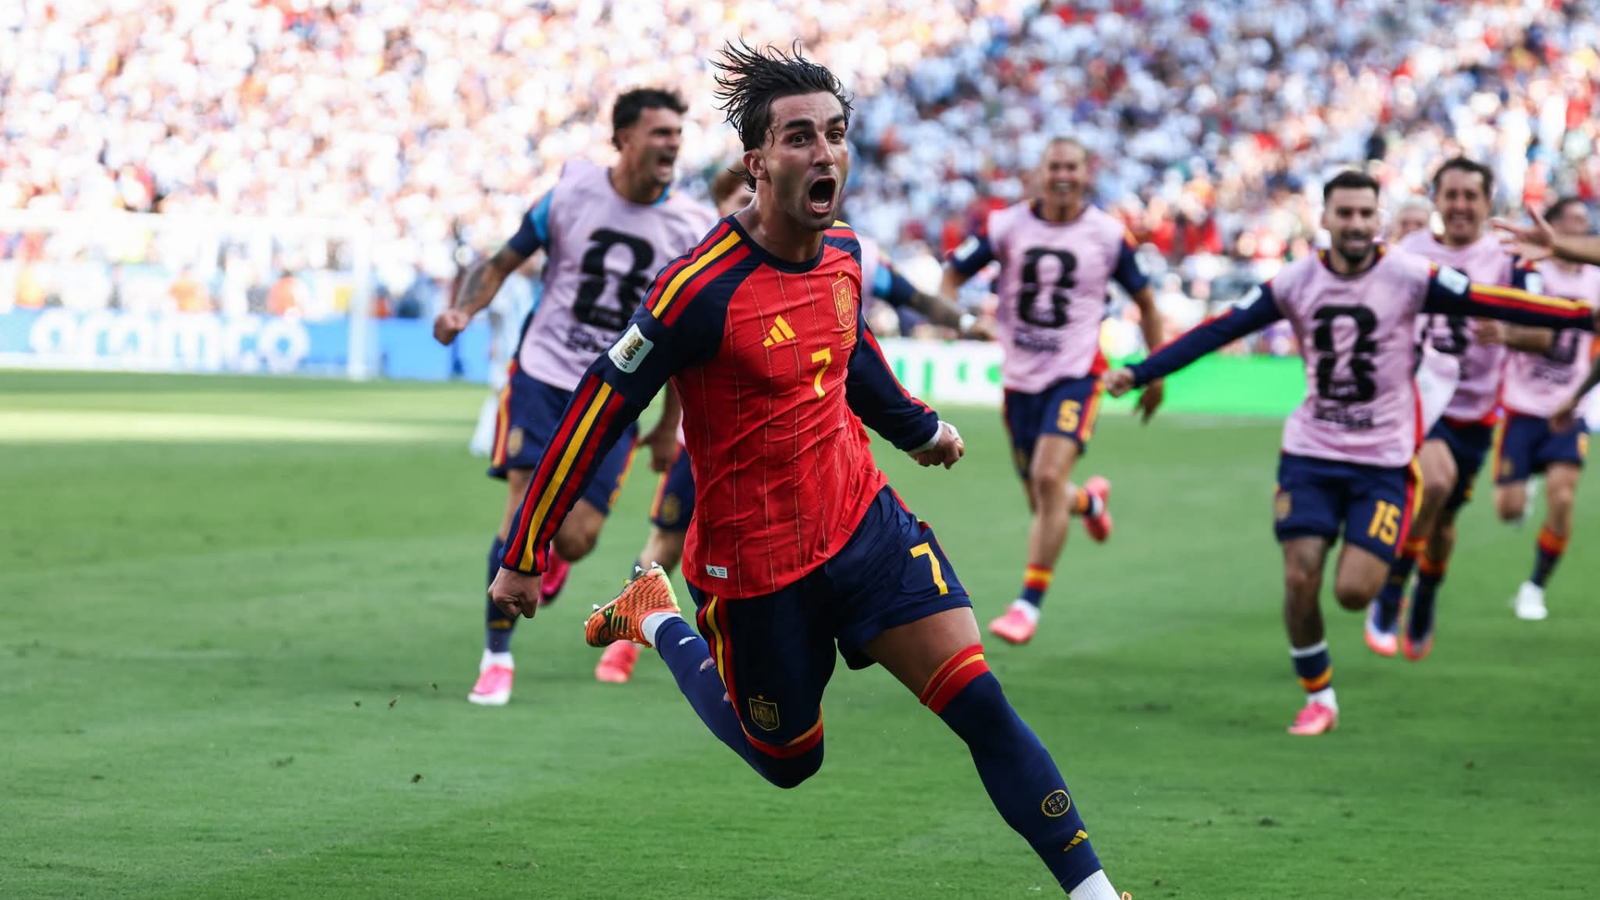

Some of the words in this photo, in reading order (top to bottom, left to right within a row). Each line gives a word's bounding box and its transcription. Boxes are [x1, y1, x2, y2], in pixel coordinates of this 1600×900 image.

[811, 347, 832, 400] 7
[1057, 398, 1082, 433] 5
[1368, 499, 1402, 546] 15
[910, 541, 949, 597] 7
